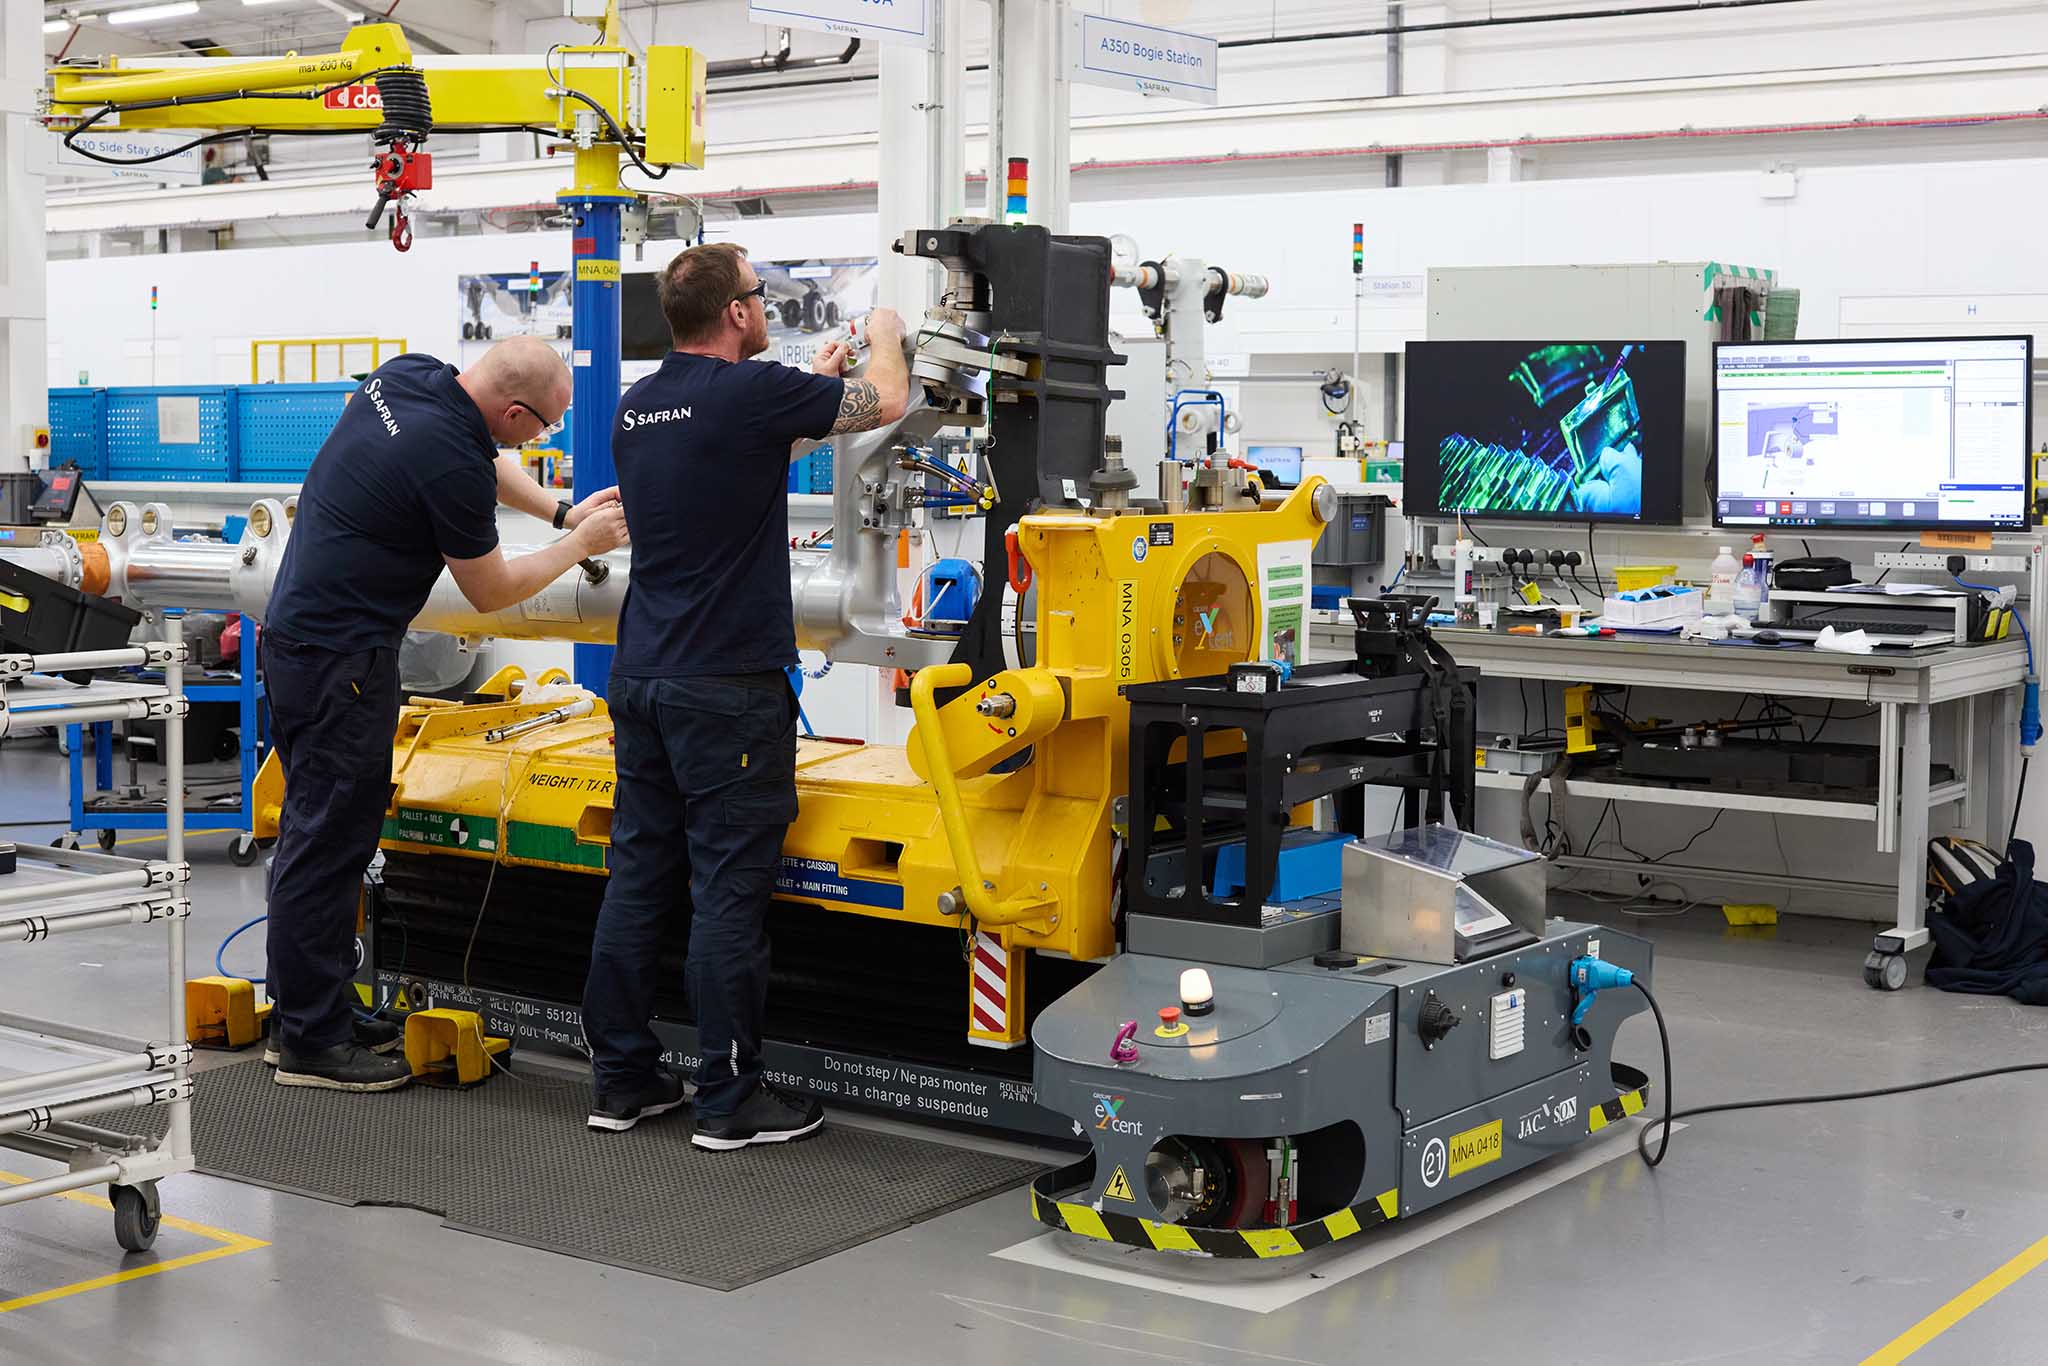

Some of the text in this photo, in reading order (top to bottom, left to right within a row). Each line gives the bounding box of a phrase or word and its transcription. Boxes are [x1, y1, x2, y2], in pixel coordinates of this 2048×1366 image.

[1101, 38, 1202, 66] A350 Bogie Station
[298, 58, 353, 74] max 200 Kg
[100, 141, 123, 153] Side
[127, 143, 150, 157] Stay
[369, 389, 401, 437] SAFRAN
[637, 406, 692, 426] SAFRAN
[1120, 583, 1133, 678] MNA 0305
[401, 810, 423, 821] PALLET
[806, 859, 837, 873] CAISSON
[802, 881, 821, 892] MAIN
[821, 883, 849, 895] FITTING
[490, 1017, 516, 1036] Stay
[520, 1025, 540, 1039] out
[824, 1056, 841, 1071] Do
[843, 1061, 863, 1076] not
[865, 1065, 890, 1083] step
[900, 1069, 917, 1085] Ne
[920, 1074, 940, 1089] pas
[943, 1078, 988, 1096] monter
[808, 1076, 839, 1094] sous
[844, 1081, 859, 1097] la
[864, 1085, 911, 1108] charge
[917, 1096, 989, 1119] suspendue
[1452, 1132, 1500, 1165] MNA 0418
[1425, 1148, 1443, 1177] 21
